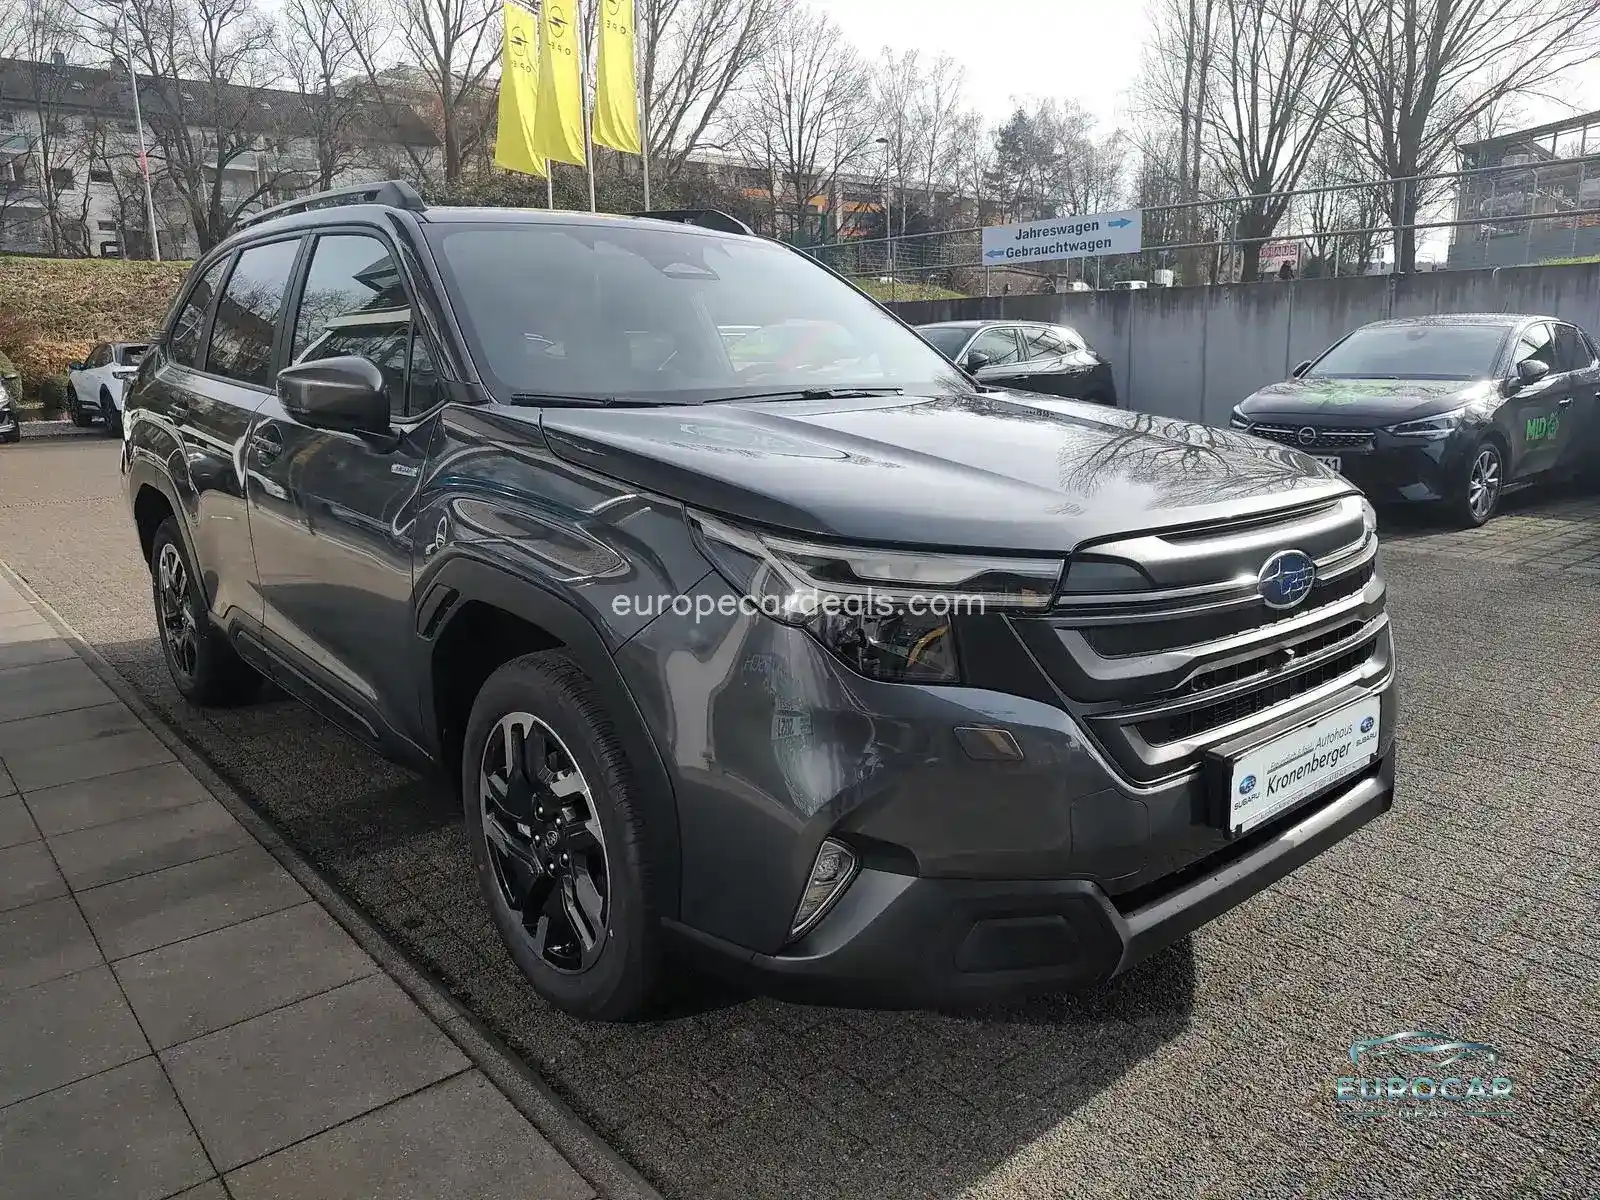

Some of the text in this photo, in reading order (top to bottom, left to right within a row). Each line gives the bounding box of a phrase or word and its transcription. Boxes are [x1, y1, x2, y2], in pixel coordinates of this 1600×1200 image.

[1015, 220, 1100, 241] Jahreswagen
[1005, 238, 1112, 259] Gebrauchtwagen
[1314, 724, 1353, 751] Autohaus
[1355, 731, 1378, 747] SUBARU
[1266, 742, 1352, 797] Kronenberger
[1234, 793, 1261, 811] SUBARU
